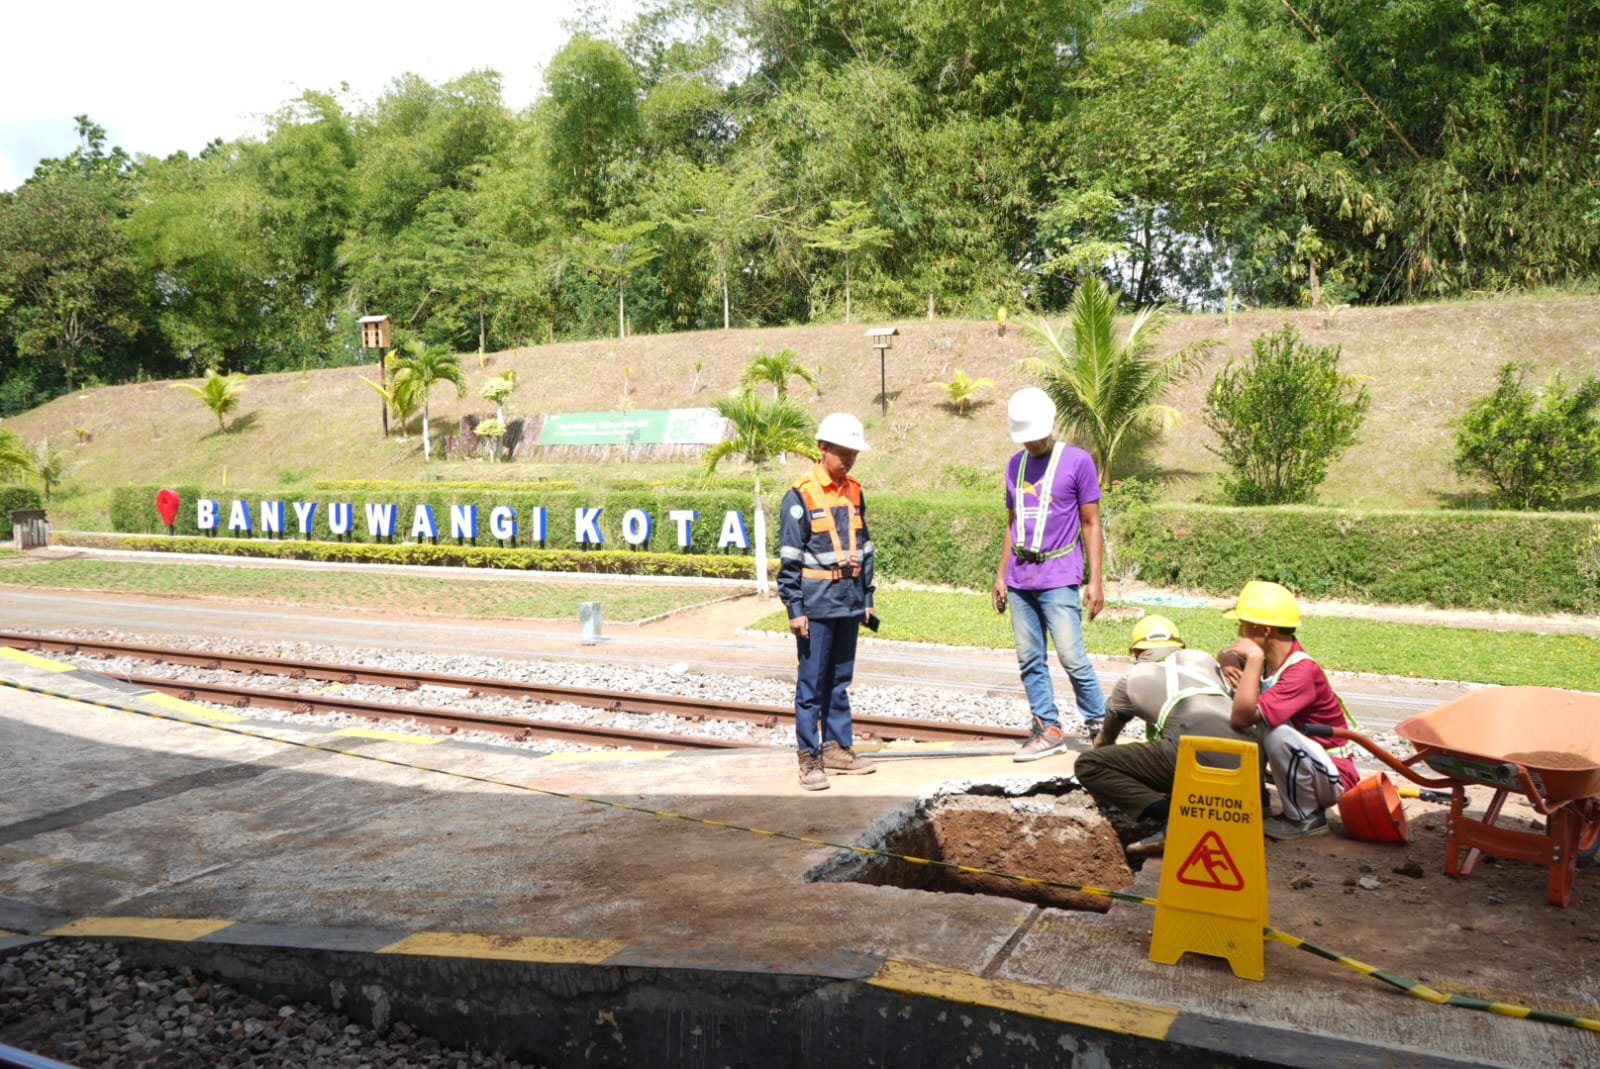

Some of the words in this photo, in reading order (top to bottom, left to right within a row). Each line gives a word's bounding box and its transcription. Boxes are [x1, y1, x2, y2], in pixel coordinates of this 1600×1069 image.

[197, 498, 547, 541] BANYUWANGI
[574, 506, 750, 549] KOTA
[1188, 793, 1242, 809] CAUTION
[1180, 805, 1205, 818] WET
[1208, 809, 1250, 824] FLOOR
